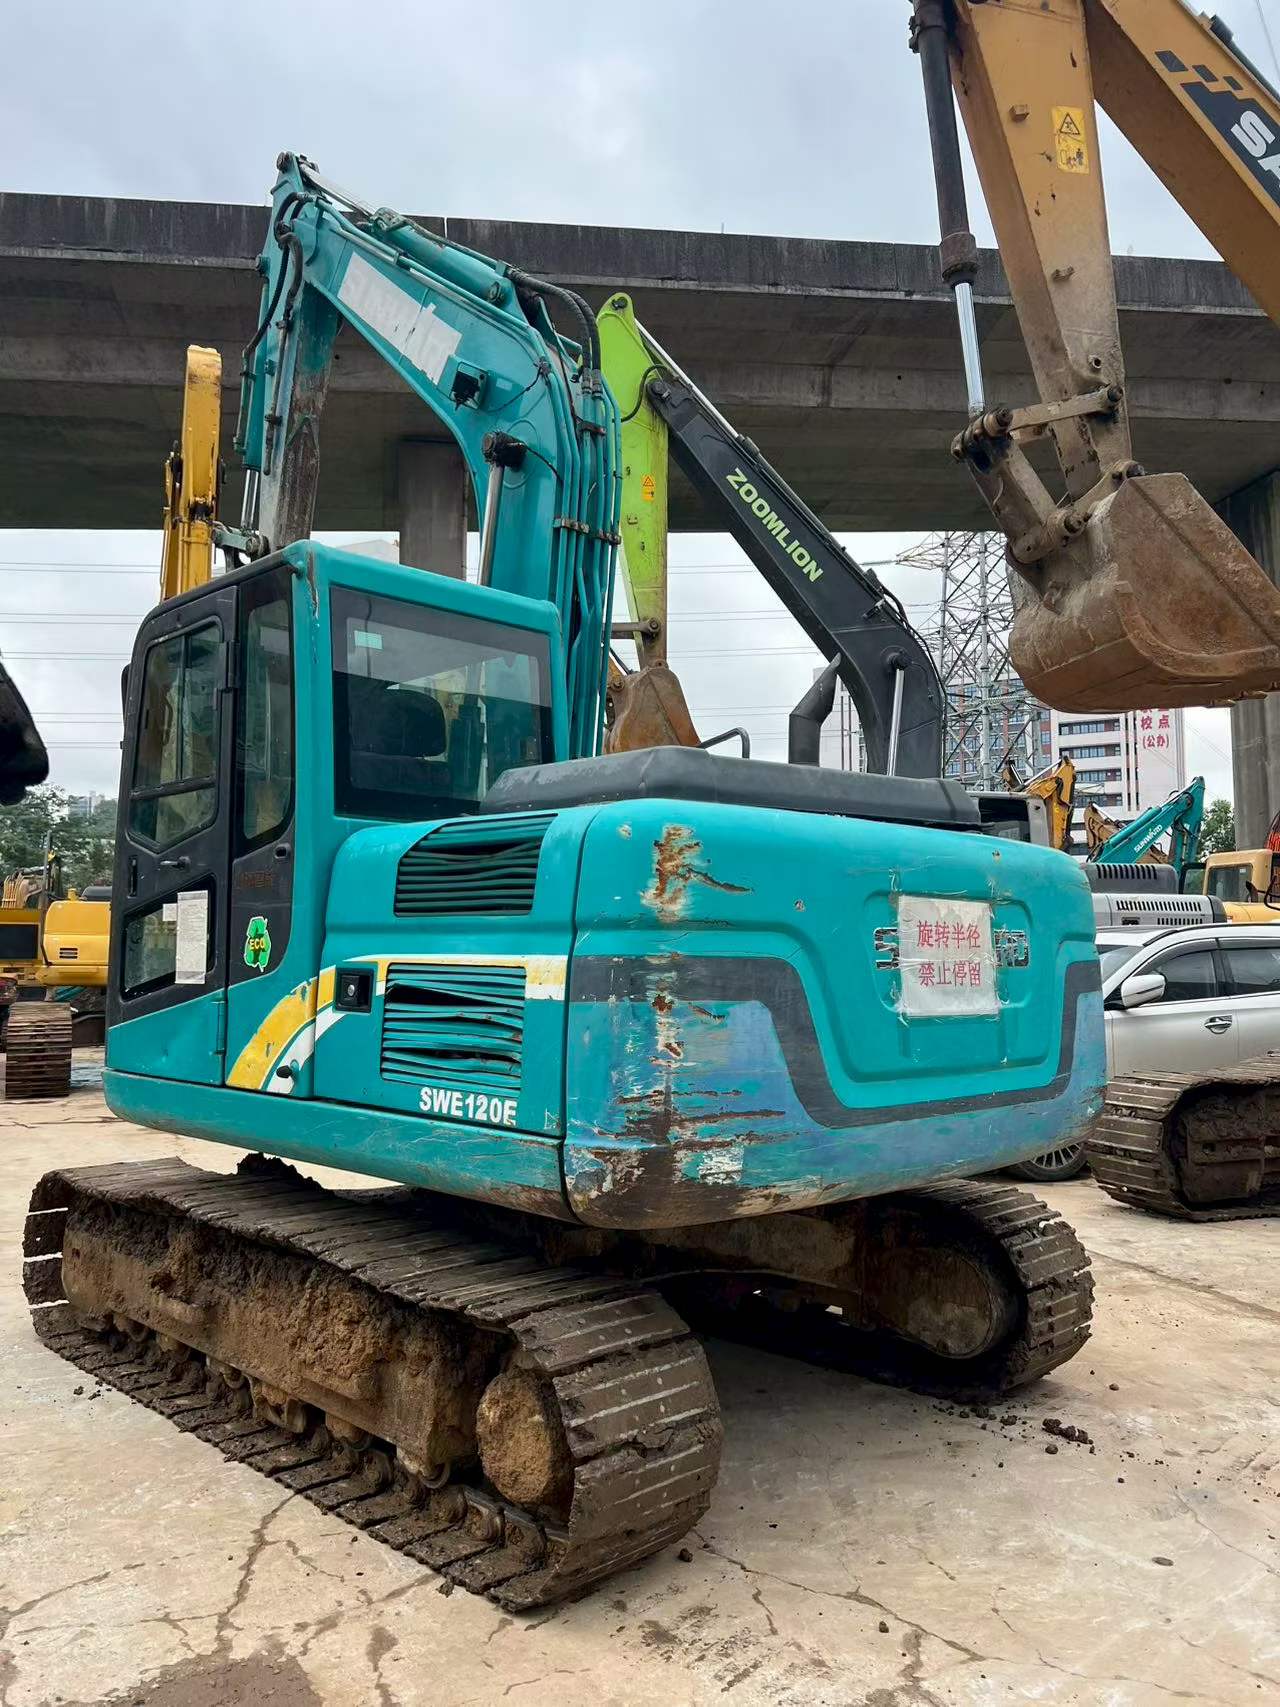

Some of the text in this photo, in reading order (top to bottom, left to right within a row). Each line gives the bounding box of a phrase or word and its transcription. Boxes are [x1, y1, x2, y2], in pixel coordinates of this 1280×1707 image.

[726, 468, 824, 582] ZOOMLION
[249, 938, 265, 950] ECO
[916, 920, 981, 949] 旋转半径
[918, 960, 981, 987] 禁止停留
[419, 1087, 518, 1126] SWE120E
